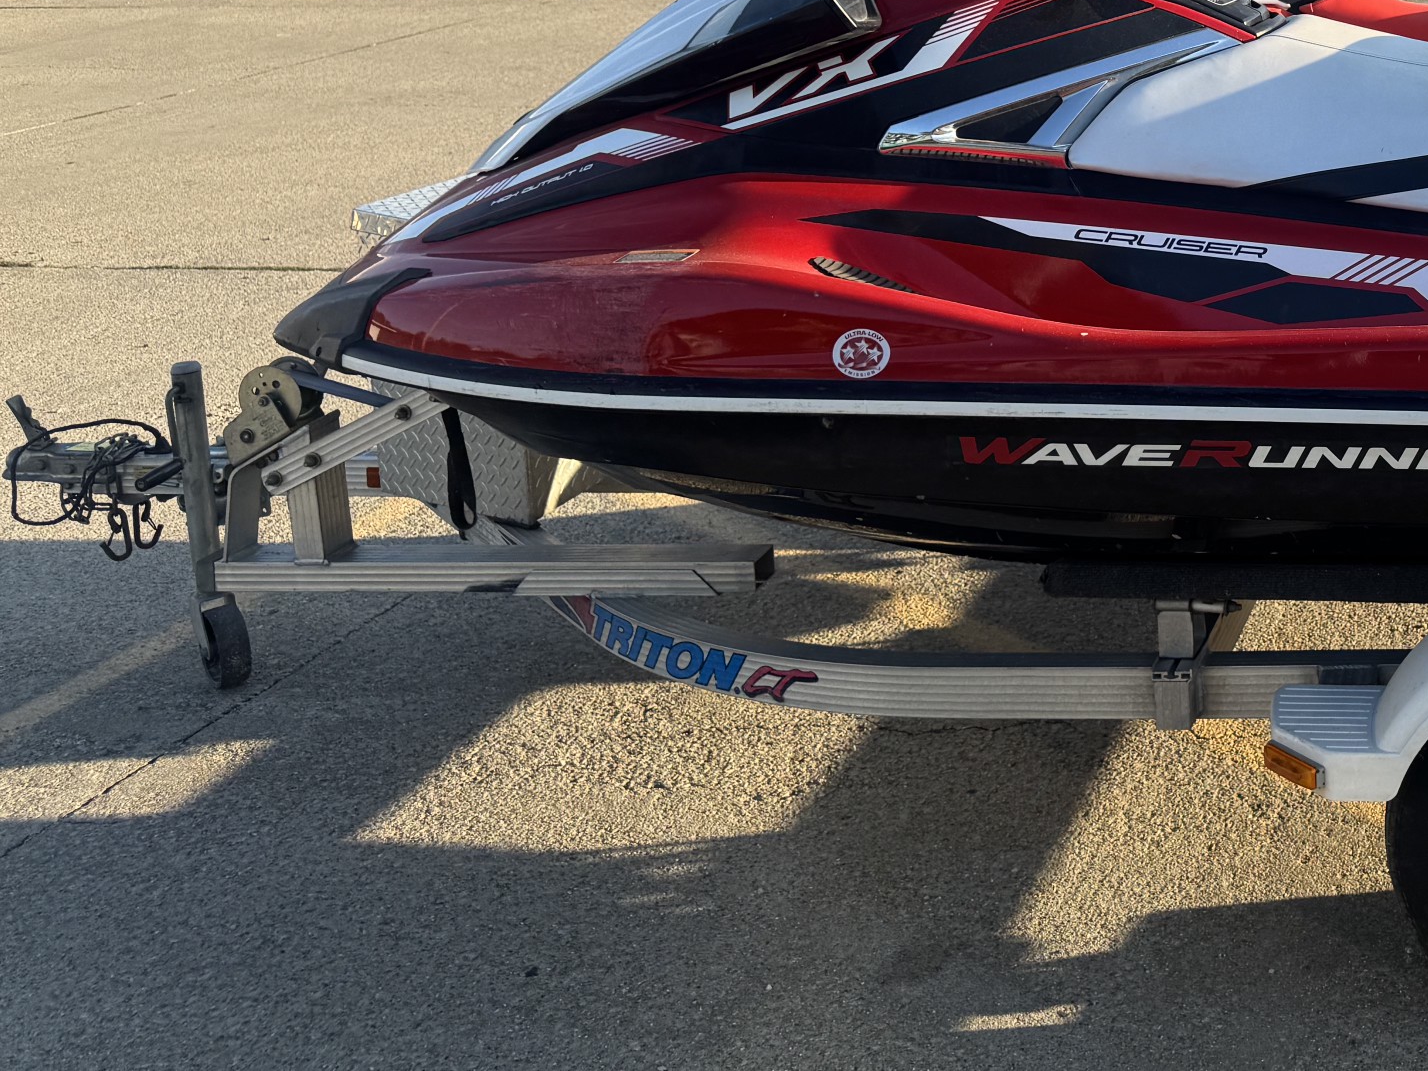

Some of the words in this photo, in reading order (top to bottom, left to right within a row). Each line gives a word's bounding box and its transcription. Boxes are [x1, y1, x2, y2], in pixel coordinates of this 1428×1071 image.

[729, 35, 901, 120] VX
[520, 169, 577, 195] OUTPUT
[1074, 228, 1268, 258] CRUISER
[844, 330, 867, 340] ULTRA
[867, 331, 884, 342] LOW
[592, 604, 748, 692] TRITON
[741, 665, 819, 703] CT
